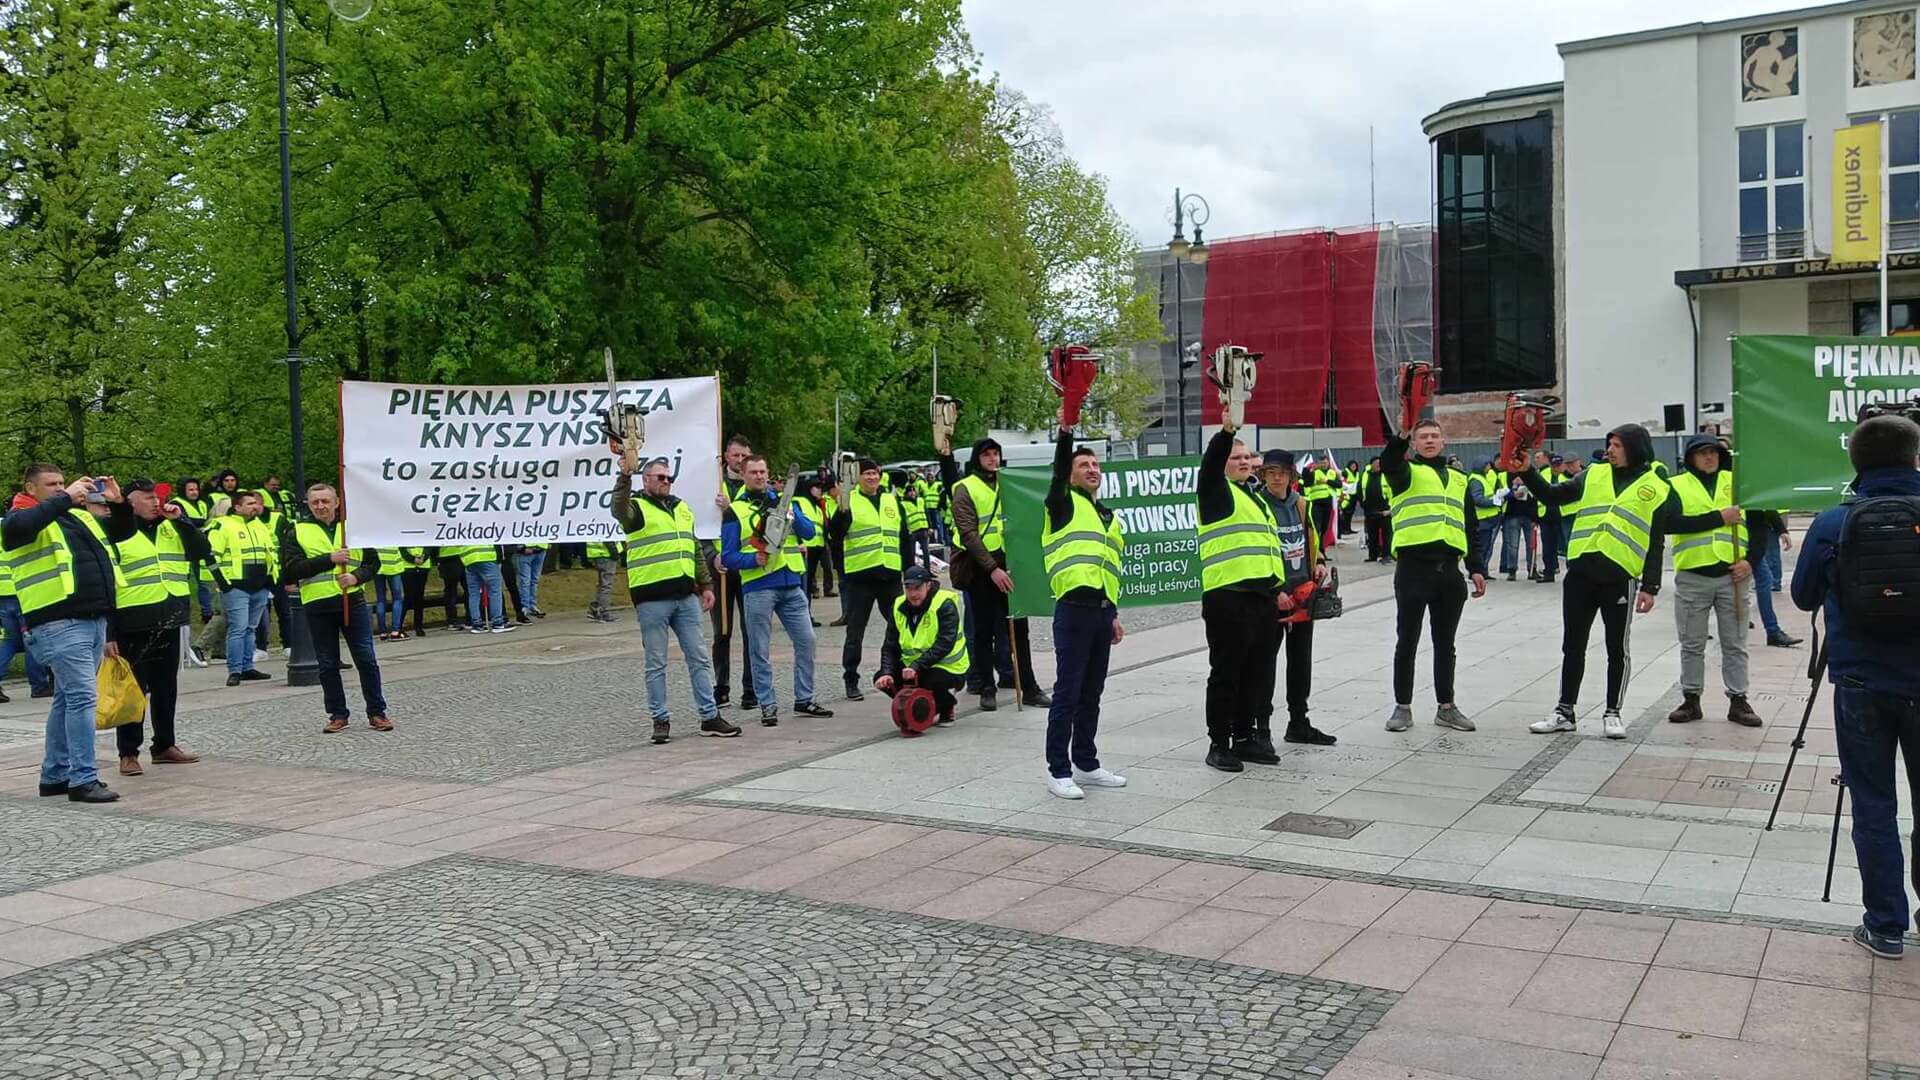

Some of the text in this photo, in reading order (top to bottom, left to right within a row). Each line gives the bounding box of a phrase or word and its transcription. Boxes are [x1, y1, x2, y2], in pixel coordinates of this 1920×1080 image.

[1709, 264, 1777, 280] TEATR
[1814, 344, 1920, 388] PIĘKNA
[388, 388, 515, 421] PIĘKNA
[420, 415, 608, 448] KNYSZYŃS
[382, 448, 682, 485] to zasługa nazej
[411, 485, 613, 518] ciężkiej pra
[435, 518, 623, 543] Zakłady Usług Leśnyc
[1113, 503, 1198, 534] STOWSKA
[1155, 535, 1199, 554] naszej
[1120, 559, 1188, 579] kiej pracy
[1126, 581, 1157, 596] Usług
[1159, 575, 1201, 593] Leśnych
